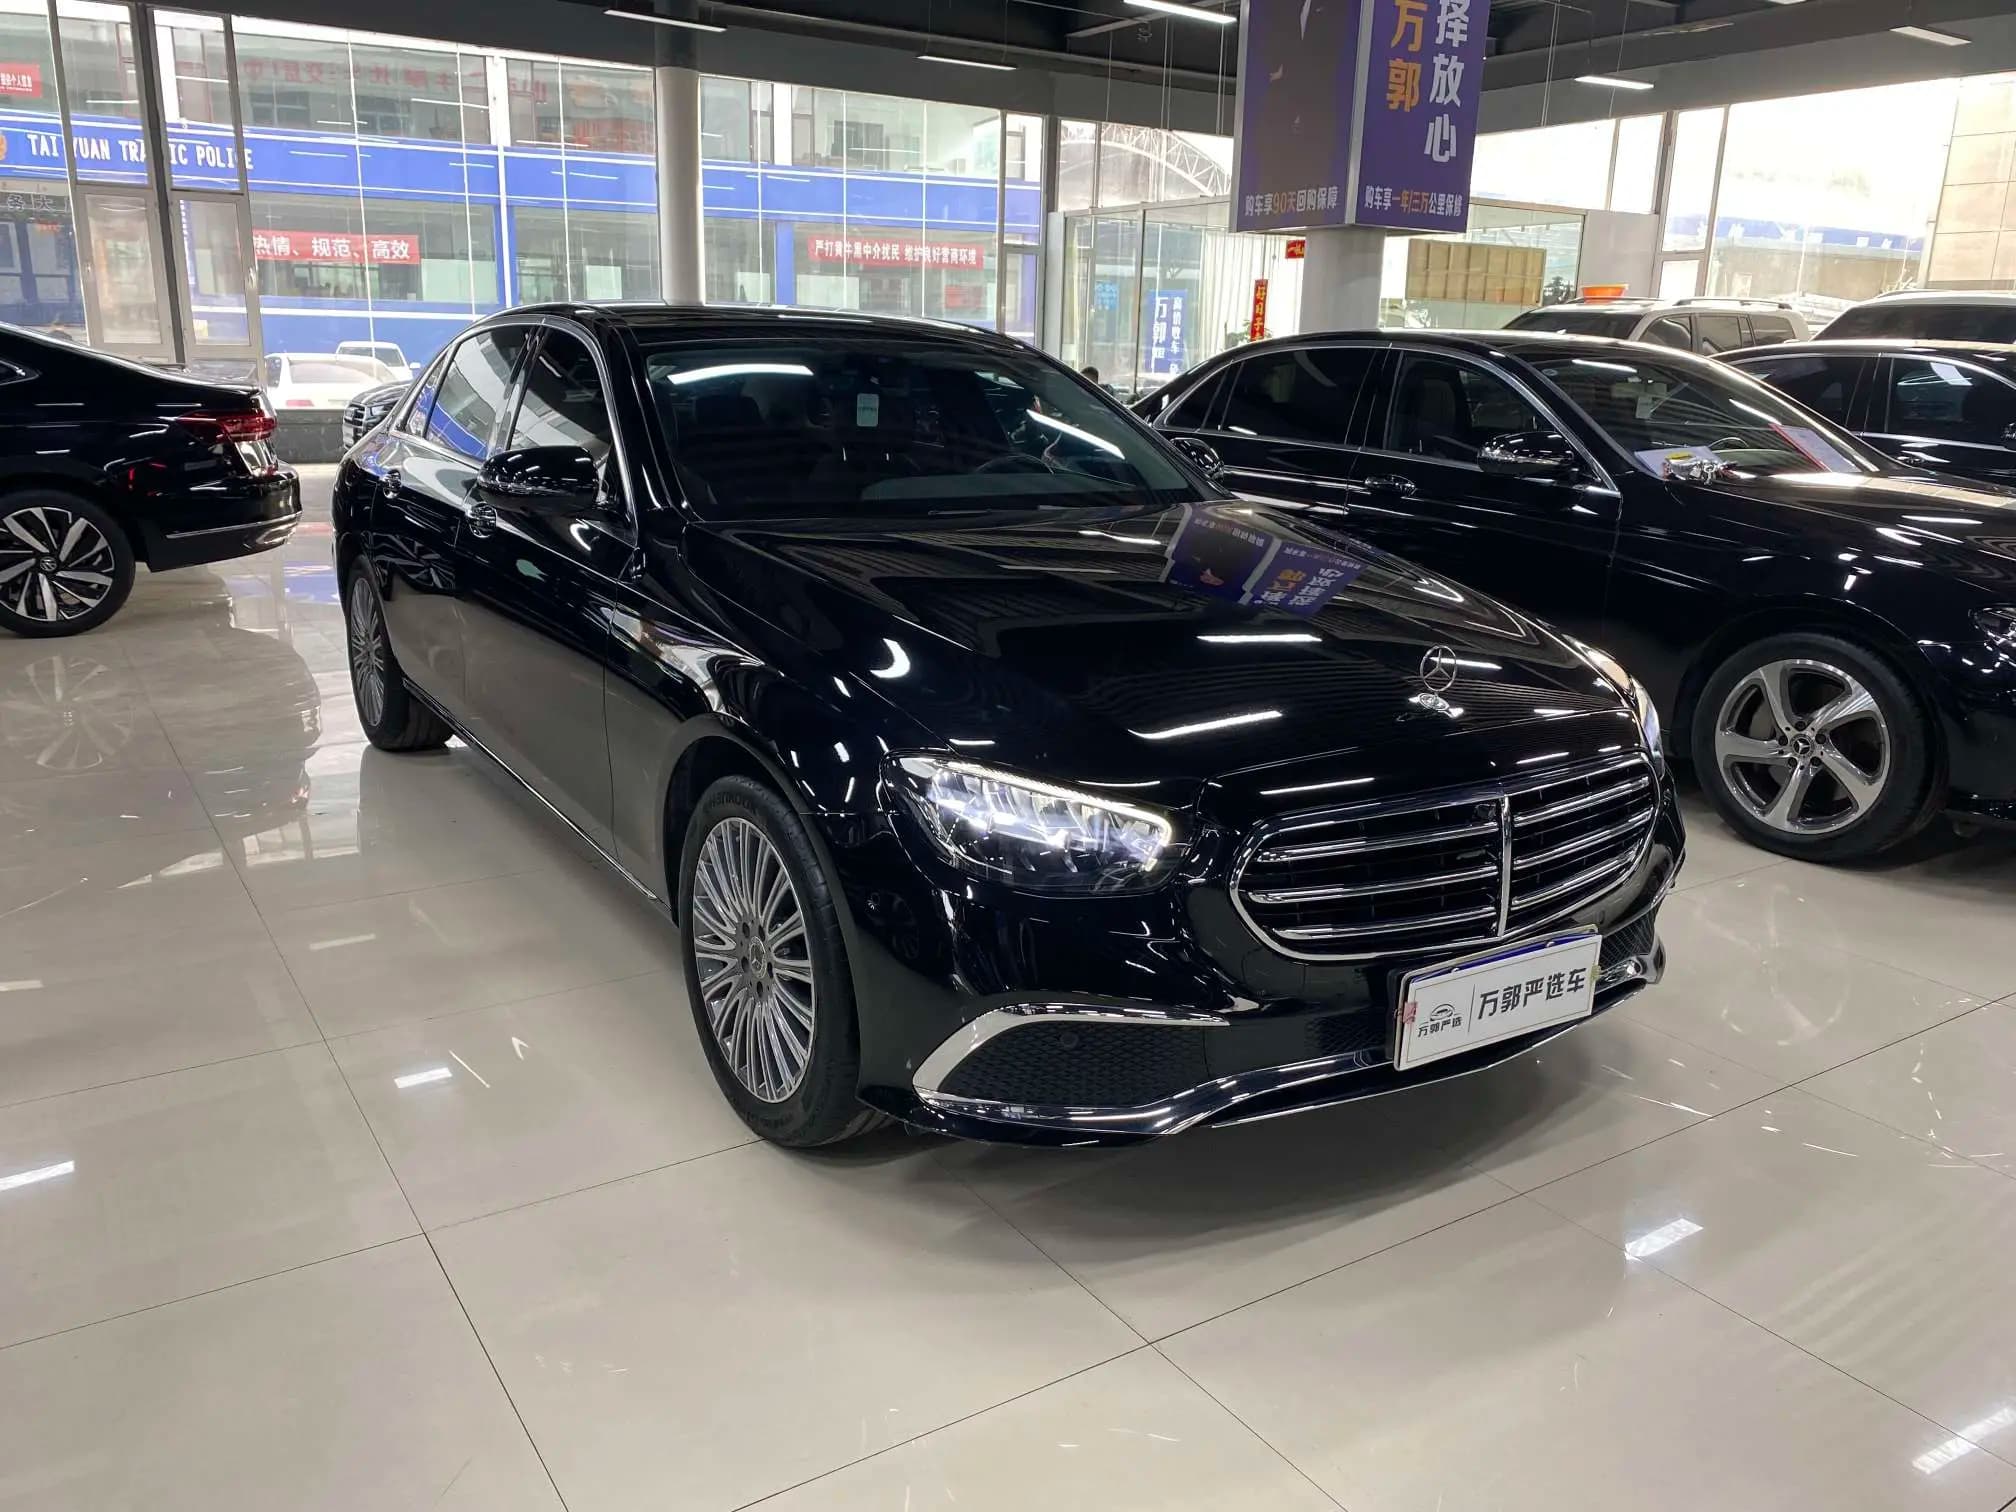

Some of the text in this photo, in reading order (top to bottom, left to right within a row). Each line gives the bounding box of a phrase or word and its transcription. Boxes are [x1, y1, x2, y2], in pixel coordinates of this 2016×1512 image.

[1386, 0, 1428, 113] 万郭
[1423, 0, 1471, 163] 择放心
[27, 134, 59, 158] TAI
[118, 139, 189, 166] TRAIC
[195, 144, 255, 170] POLIE
[1244, 185, 1339, 217] 购车享90天回购保障
[1364, 185, 1463, 217] 购车享一年/三万公里保修
[1477, 967, 1587, 1020] 万郭严选车
[1417, 1016, 1463, 1038] 万郭严选
